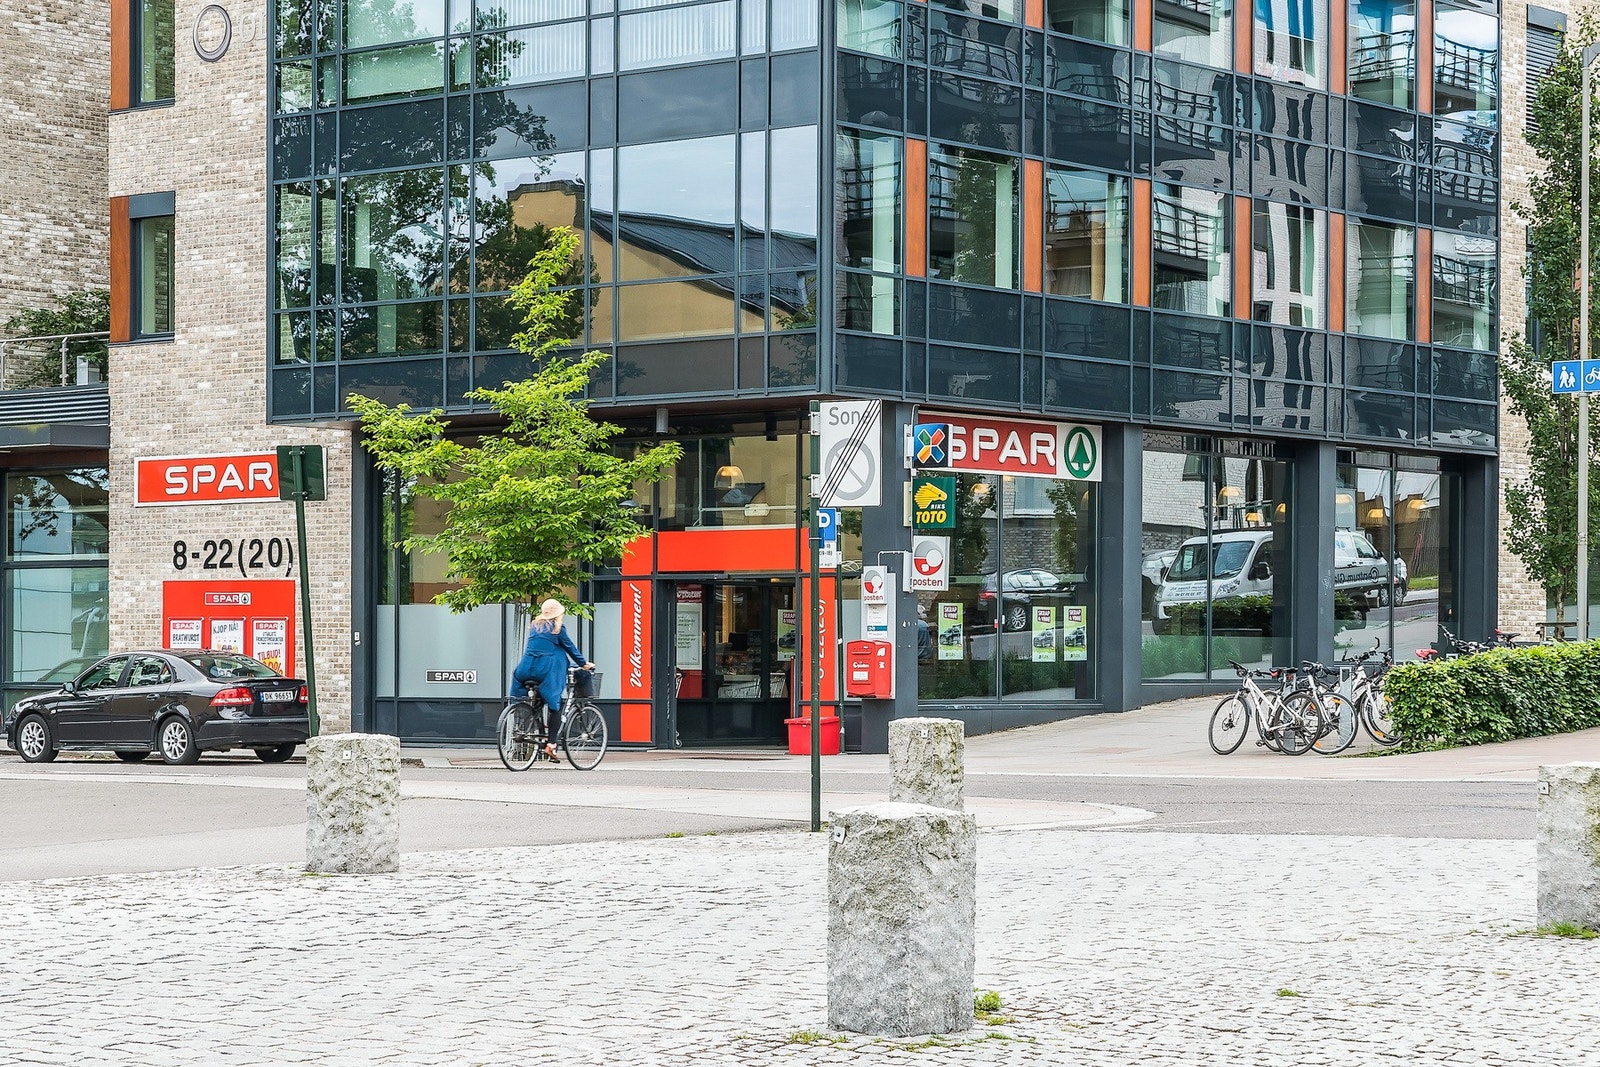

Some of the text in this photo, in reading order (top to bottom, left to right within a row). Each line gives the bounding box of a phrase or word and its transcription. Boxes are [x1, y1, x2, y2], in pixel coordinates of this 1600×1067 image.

[165, 461, 273, 495] SPAR
[915, 510, 947, 524] TOTO
[172, 537, 293, 578] 8-22(20)
[912, 577, 943, 587] posten
[212, 594, 239, 603] SPAR
[172, 633, 200, 642] BRATWURST
[629, 583, 643, 688] Velkommen!
[257, 648, 281, 661] TILBUD!
[434, 672, 464, 681] SPAR
[264, 692, 273, 700] DK
